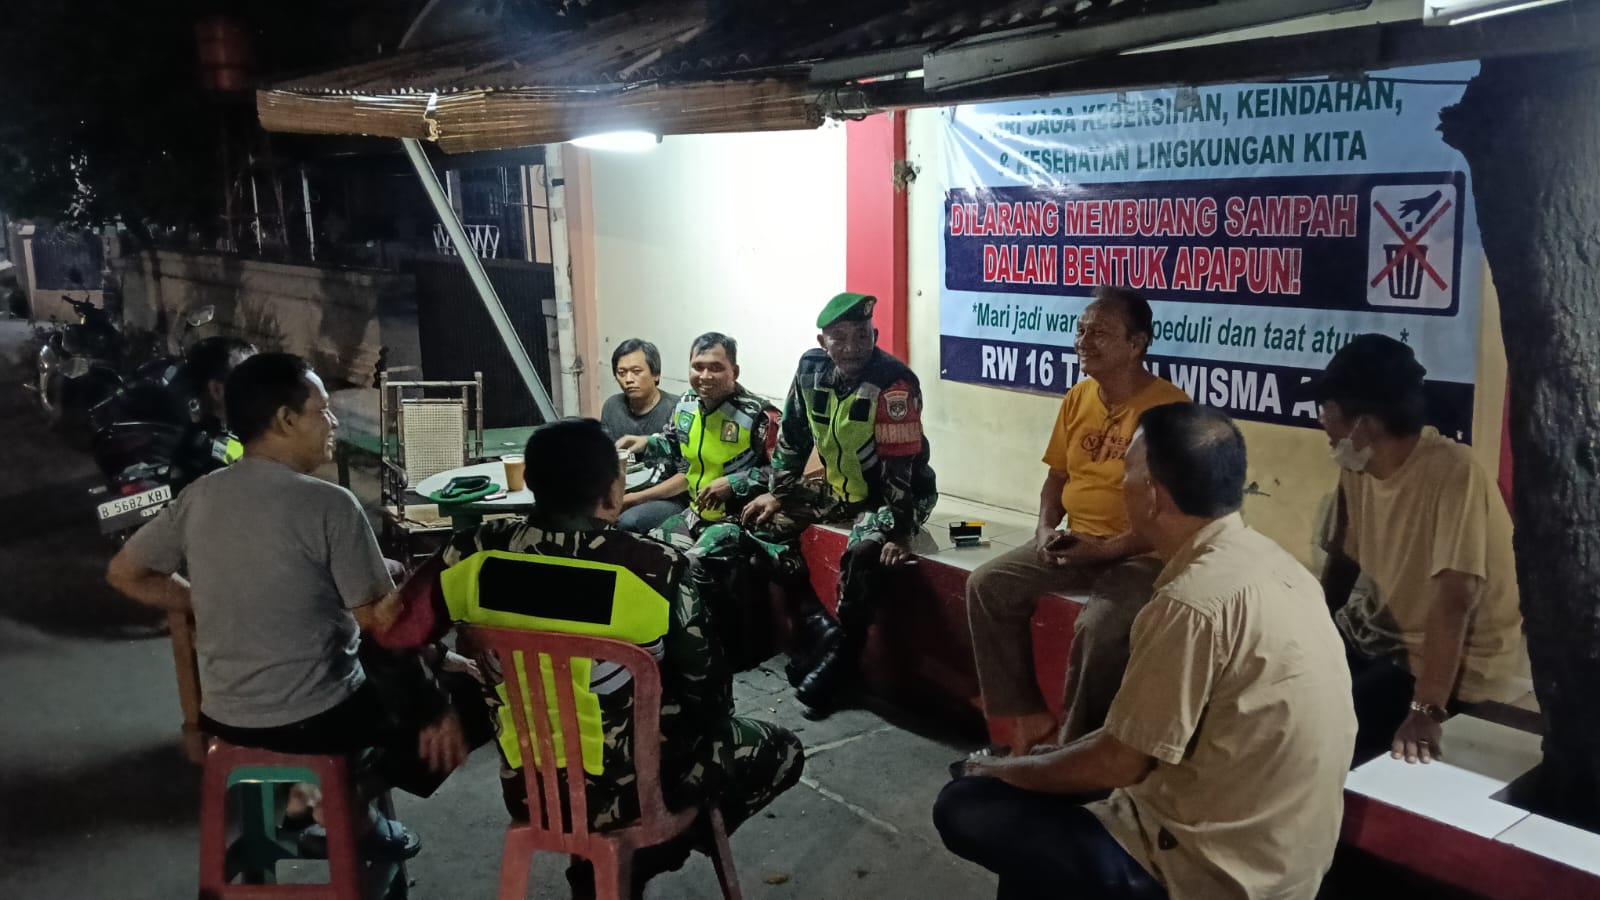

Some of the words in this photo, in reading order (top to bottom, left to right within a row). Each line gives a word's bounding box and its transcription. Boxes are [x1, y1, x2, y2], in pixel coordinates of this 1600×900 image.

[1027, 106, 1076, 136] JAGA
[1236, 79, 1403, 117] KEINDAHAN,
[999, 151, 1011, 175] &
[1015, 143, 1130, 176] KESEHATAN
[1135, 134, 1295, 170] LINGKUNGAN
[1303, 130, 1367, 163] KITA
[950, 200, 1060, 237] DILARANG
[1063, 196, 1218, 238] MEMBUANG
[1223, 194, 1359, 238] SAMPAH
[983, 244, 1058, 285] DALAM
[1062, 245, 1169, 290] BENTUK
[1171, 246, 1303, 295] APAPUN!
[1012, 305, 1043, 336] jadi
[1046, 312, 1081, 333] war
[1149, 314, 1213, 347] peduli
[1217, 317, 1257, 348] dan
[1263, 321, 1307, 352] taat
[981, 344, 1019, 382] RW
[1026, 349, 1054, 387] 16
[1168, 362, 1283, 415] WISMA
[101, 506, 110, 518] B
